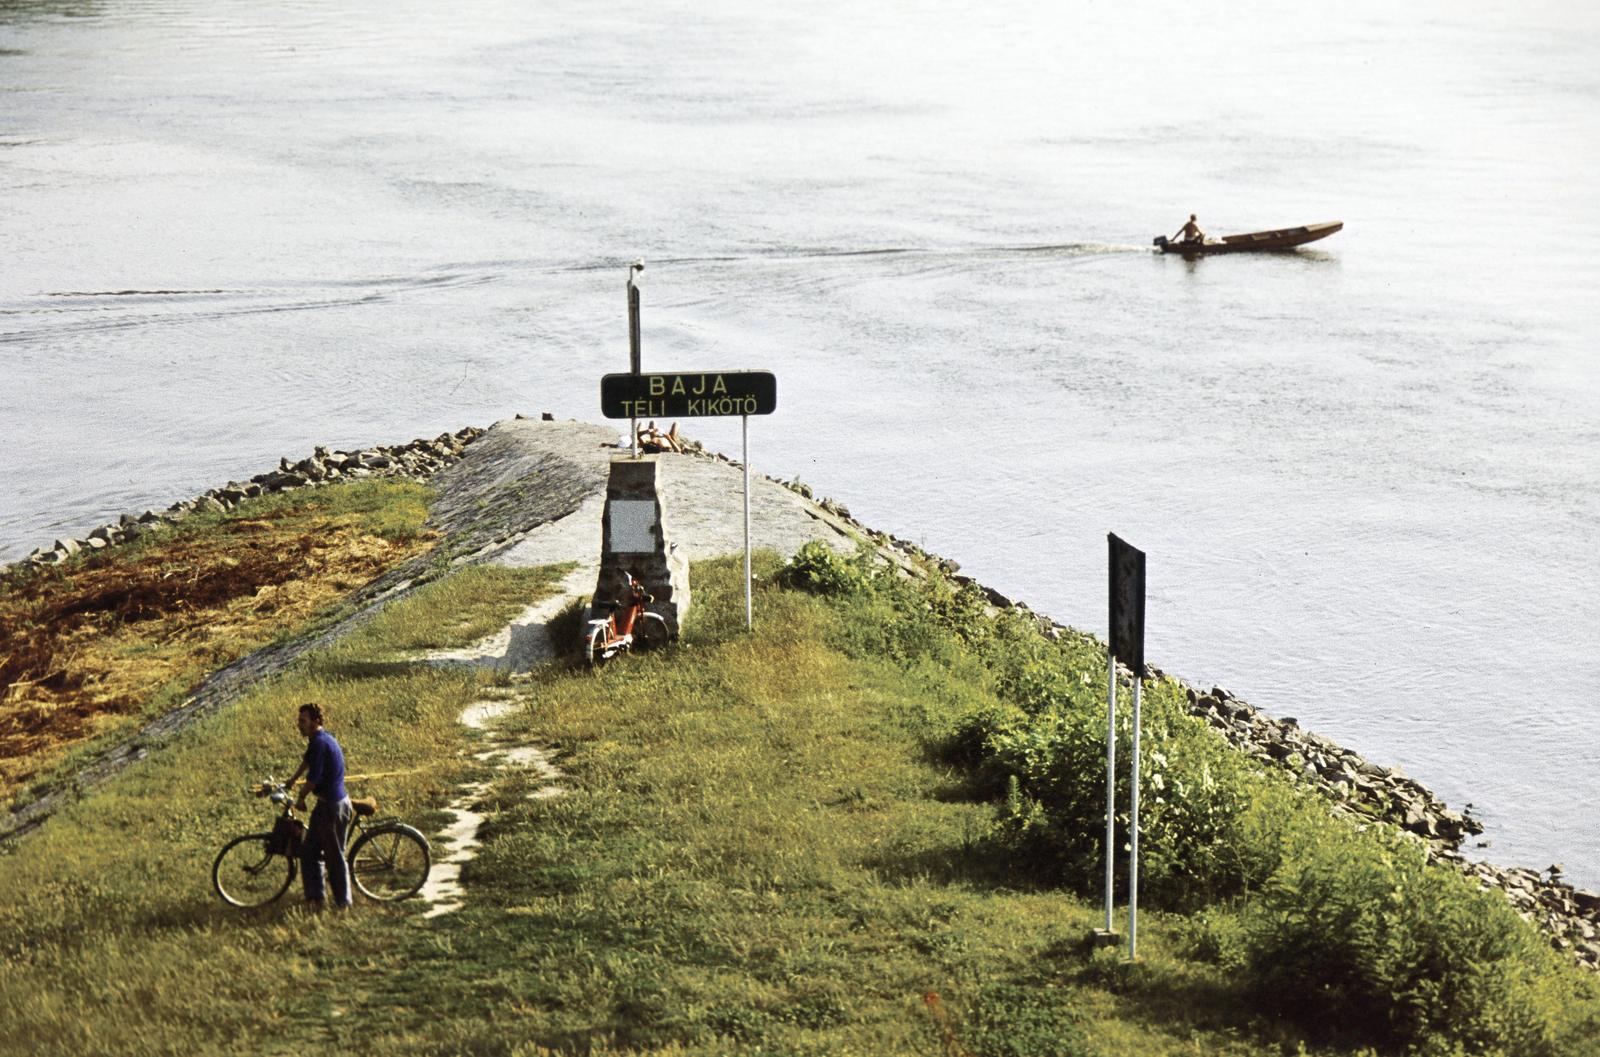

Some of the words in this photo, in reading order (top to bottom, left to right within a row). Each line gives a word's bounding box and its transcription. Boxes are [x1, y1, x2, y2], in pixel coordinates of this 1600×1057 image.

[649, 375, 727, 396] BAJA
[621, 397, 665, 417] TÉLI
[688, 394, 757, 415] KIKÖTÖ
